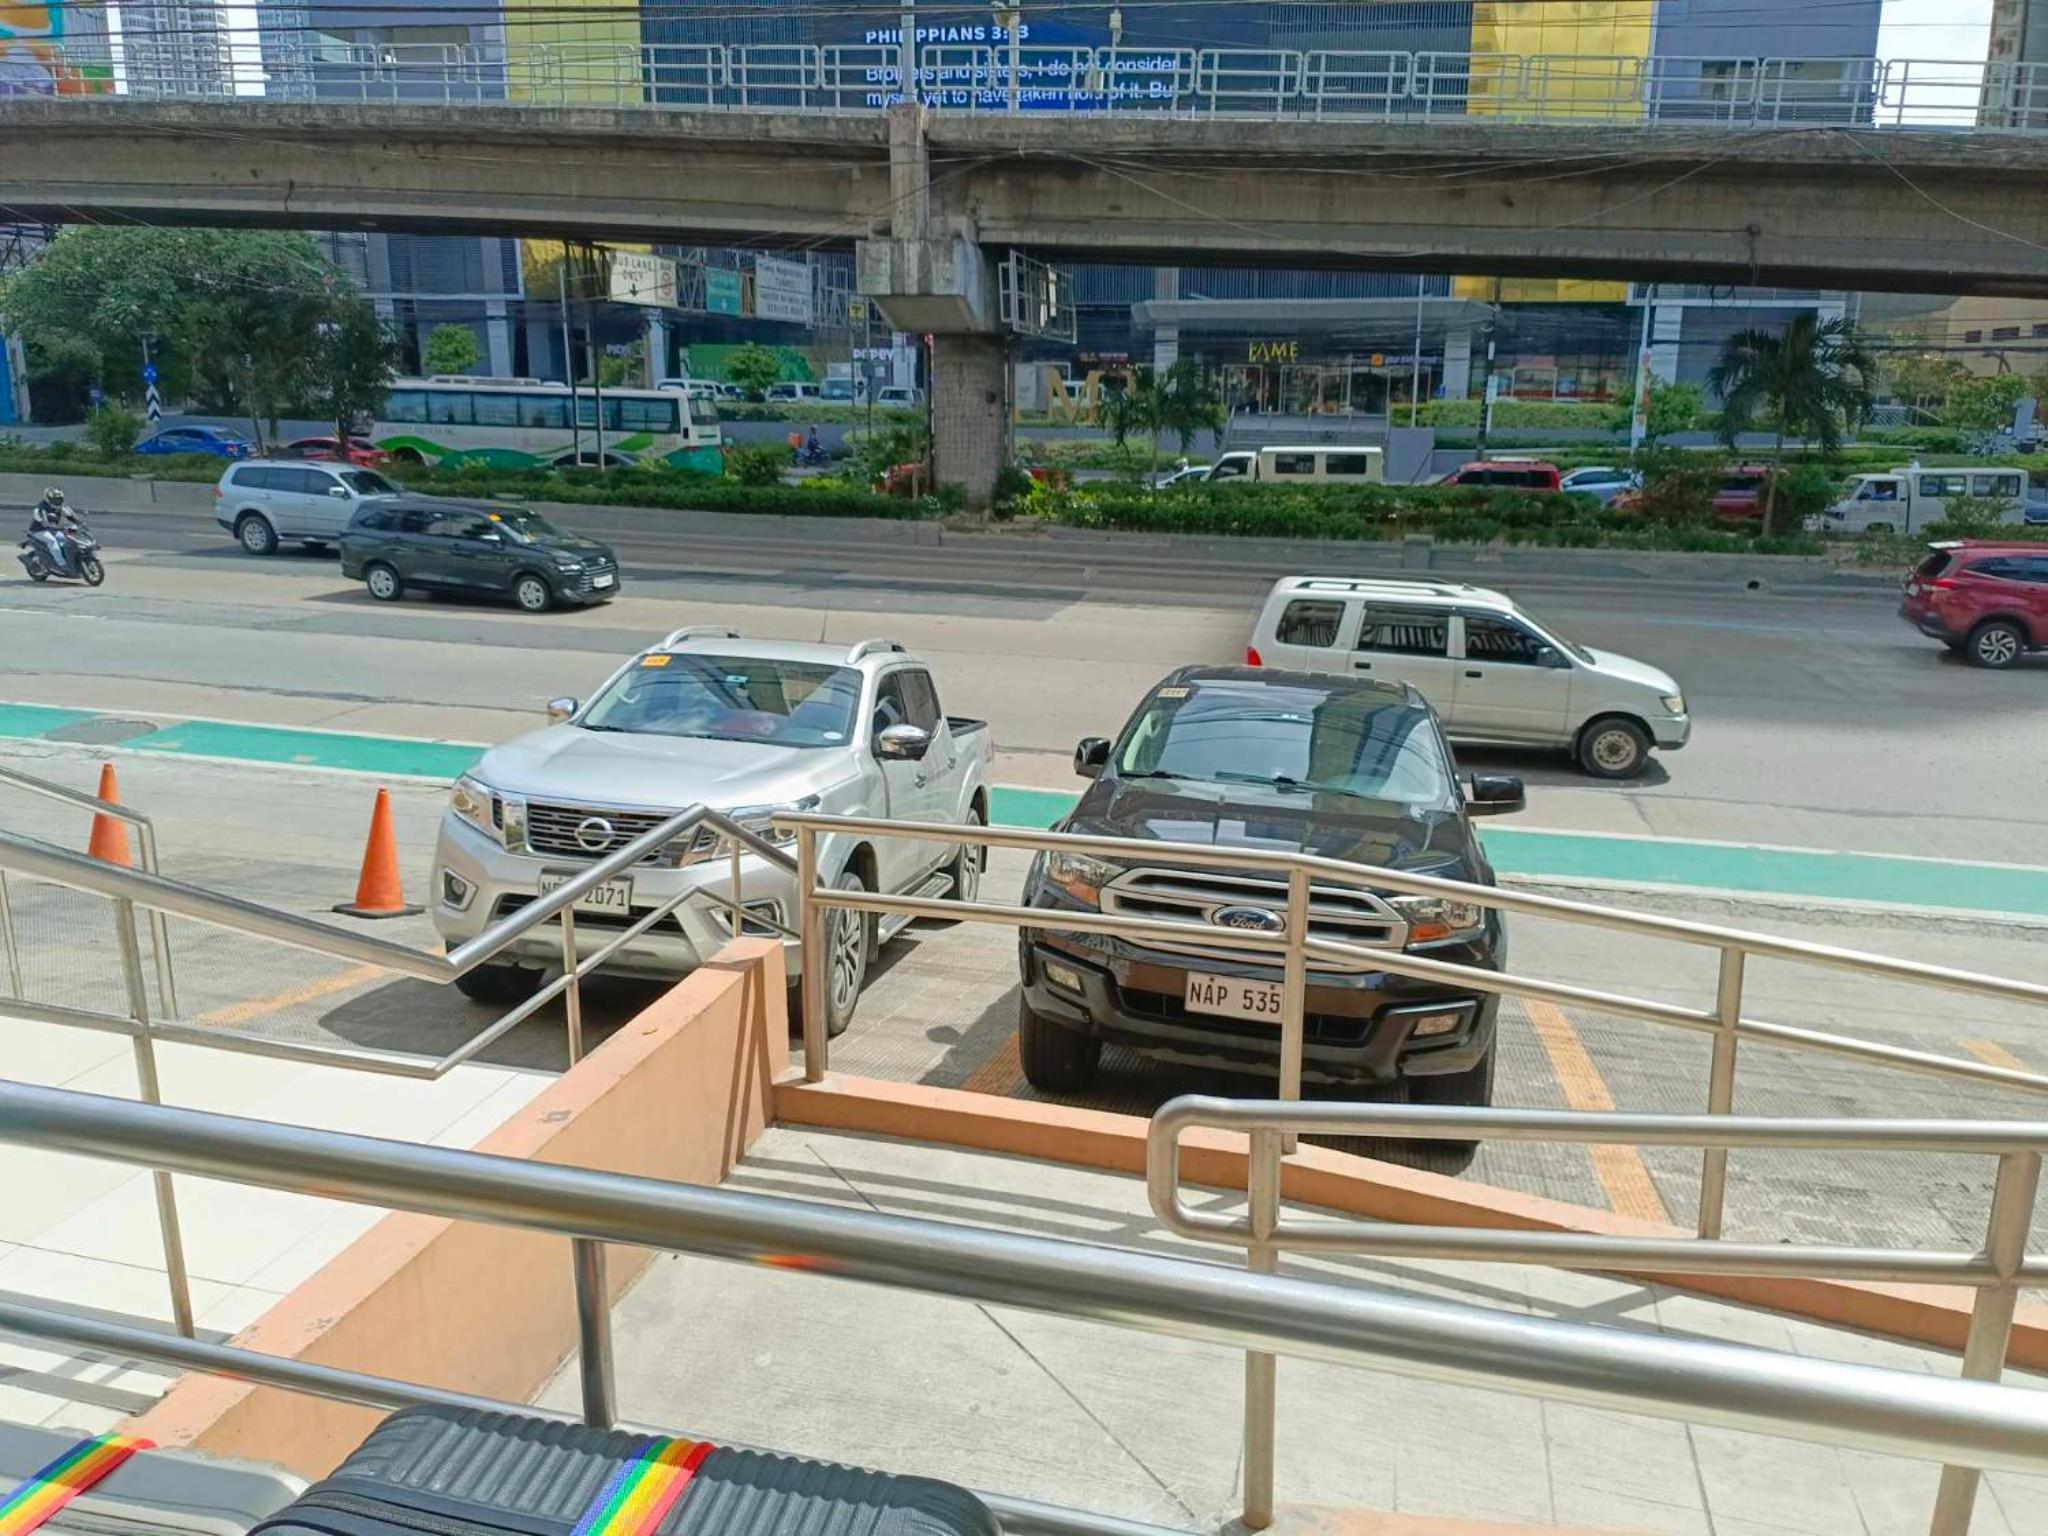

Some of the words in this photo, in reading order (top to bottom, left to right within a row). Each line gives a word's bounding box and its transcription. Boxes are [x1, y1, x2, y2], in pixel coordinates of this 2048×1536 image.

[866, 26, 985, 43] PHIPPIANS
[992, 25, 1029, 40] 3:3
[866, 66, 934, 81] Broers
[939, 62, 970, 79] and
[1048, 60, 1068, 76] do
[867, 89, 918, 107] mysef
[923, 89, 948, 108] yet
[952, 89, 968, 103] to
[1150, 82, 1173, 98] Bu
[1248, 341, 1298, 363] FAME
[585, 886, 625, 906] 2071
[1229, 912, 1266, 929] Ford
[1190, 982, 1228, 1006] NAP
[1243, 989, 1280, 1014] 535
